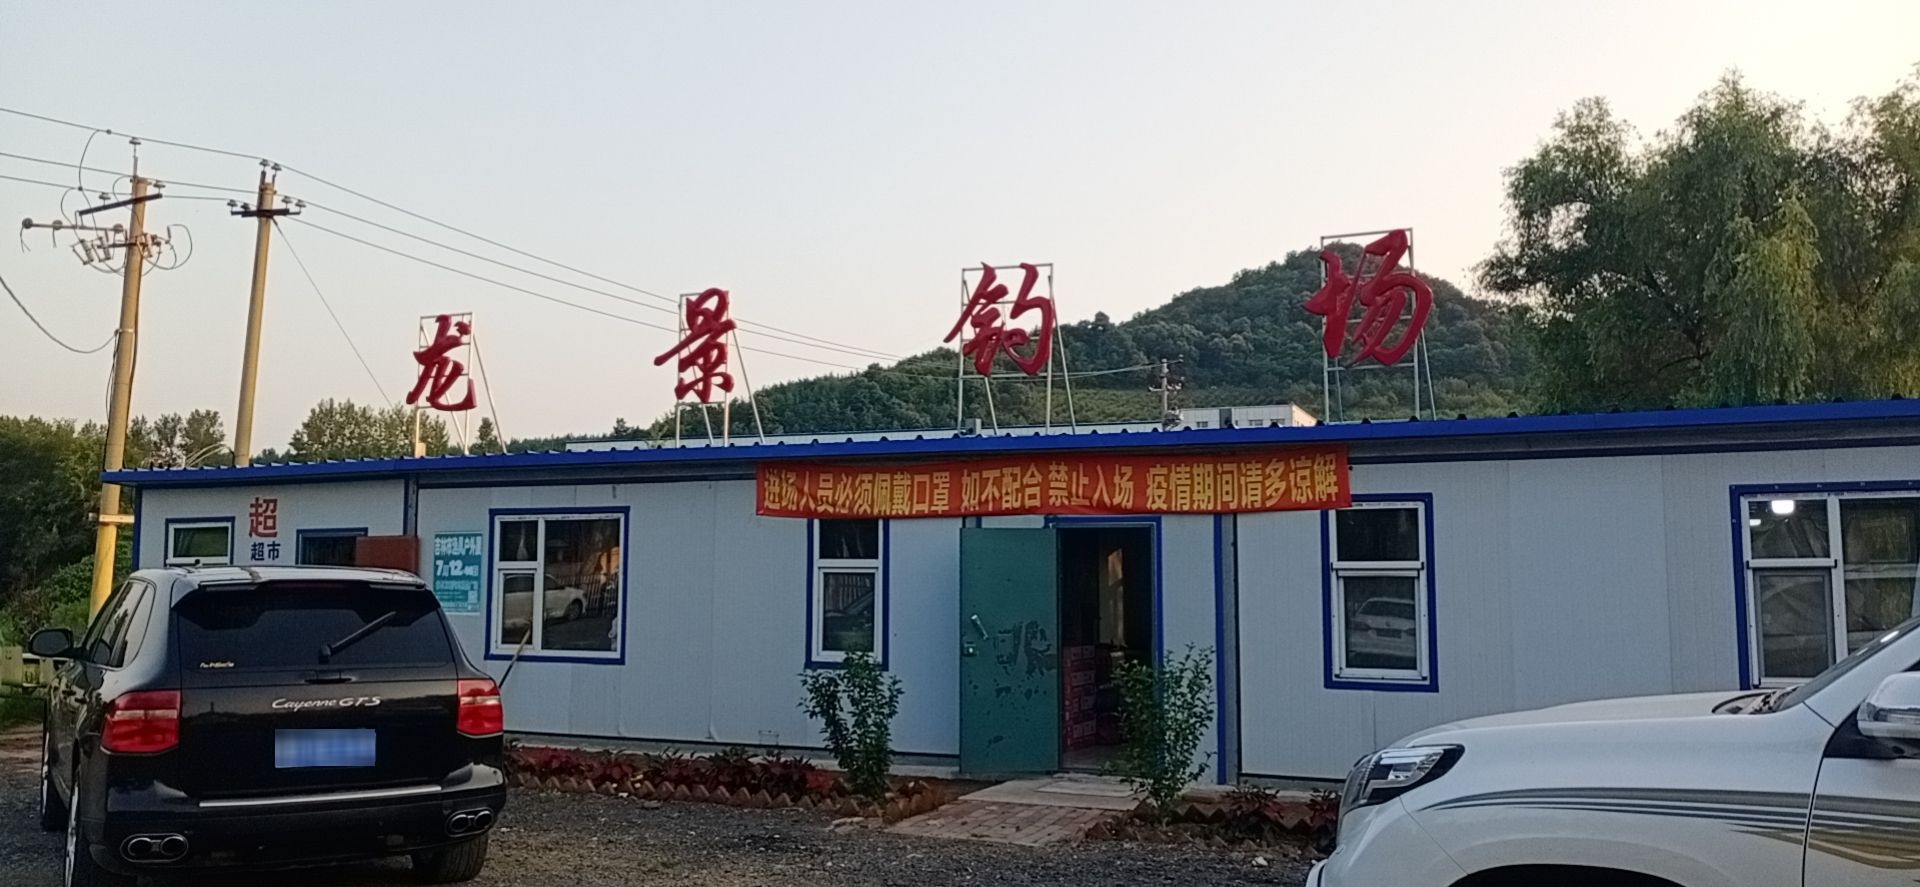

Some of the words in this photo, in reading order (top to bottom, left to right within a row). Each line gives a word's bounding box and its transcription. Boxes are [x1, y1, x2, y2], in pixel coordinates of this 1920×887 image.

[763, 467, 951, 516] 进场人员必须佩戴口罩
[961, 462, 1043, 512] 如不配合
[1048, 461, 1134, 510] 禁止入场
[1146, 453, 1339, 511] 疫情期间请多谅解
[249, 497, 278, 538] 超
[250, 541, 281, 561] 超市
[271, 698, 337, 712] Cayenne
[338, 696, 381, 708] GTS
